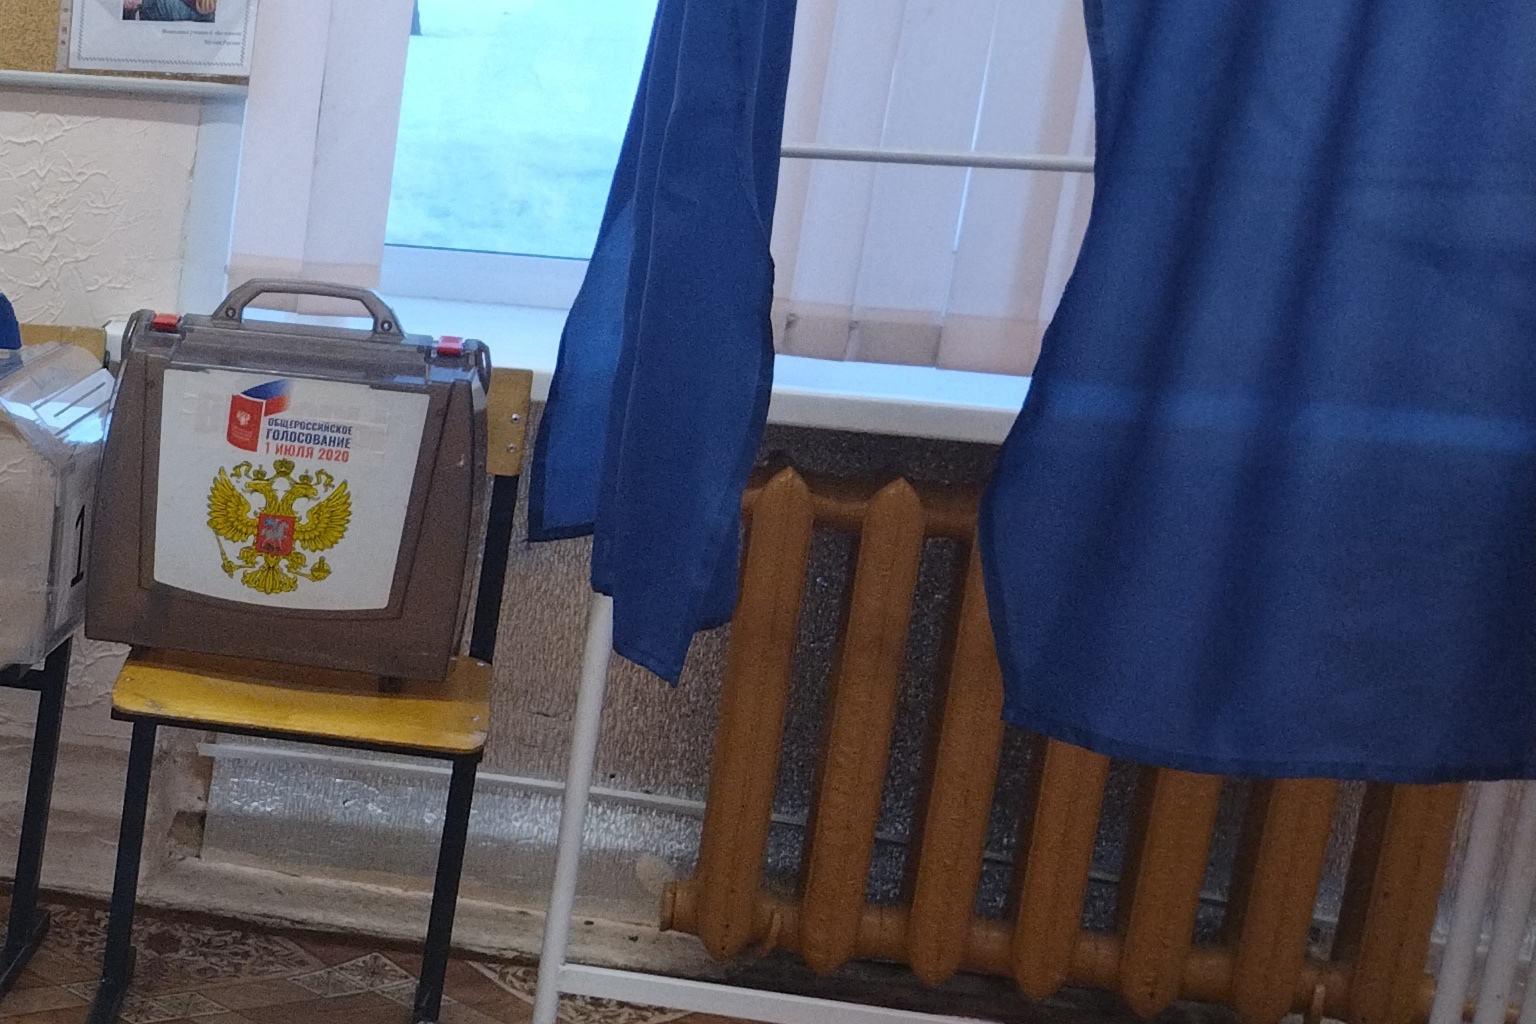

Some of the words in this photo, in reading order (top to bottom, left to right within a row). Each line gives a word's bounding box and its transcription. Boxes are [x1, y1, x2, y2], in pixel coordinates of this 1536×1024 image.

[268, 417, 353, 436] ОБЩЕРОССИЙСКОЕ
[266, 429, 351, 449] ГОЛОСОВАНИЕ
[265, 442, 270, 454] 1
[275, 444, 314, 459] ИЮЛЯ
[318, 448, 349, 462] 2020
[70, 504, 86, 588] 1
